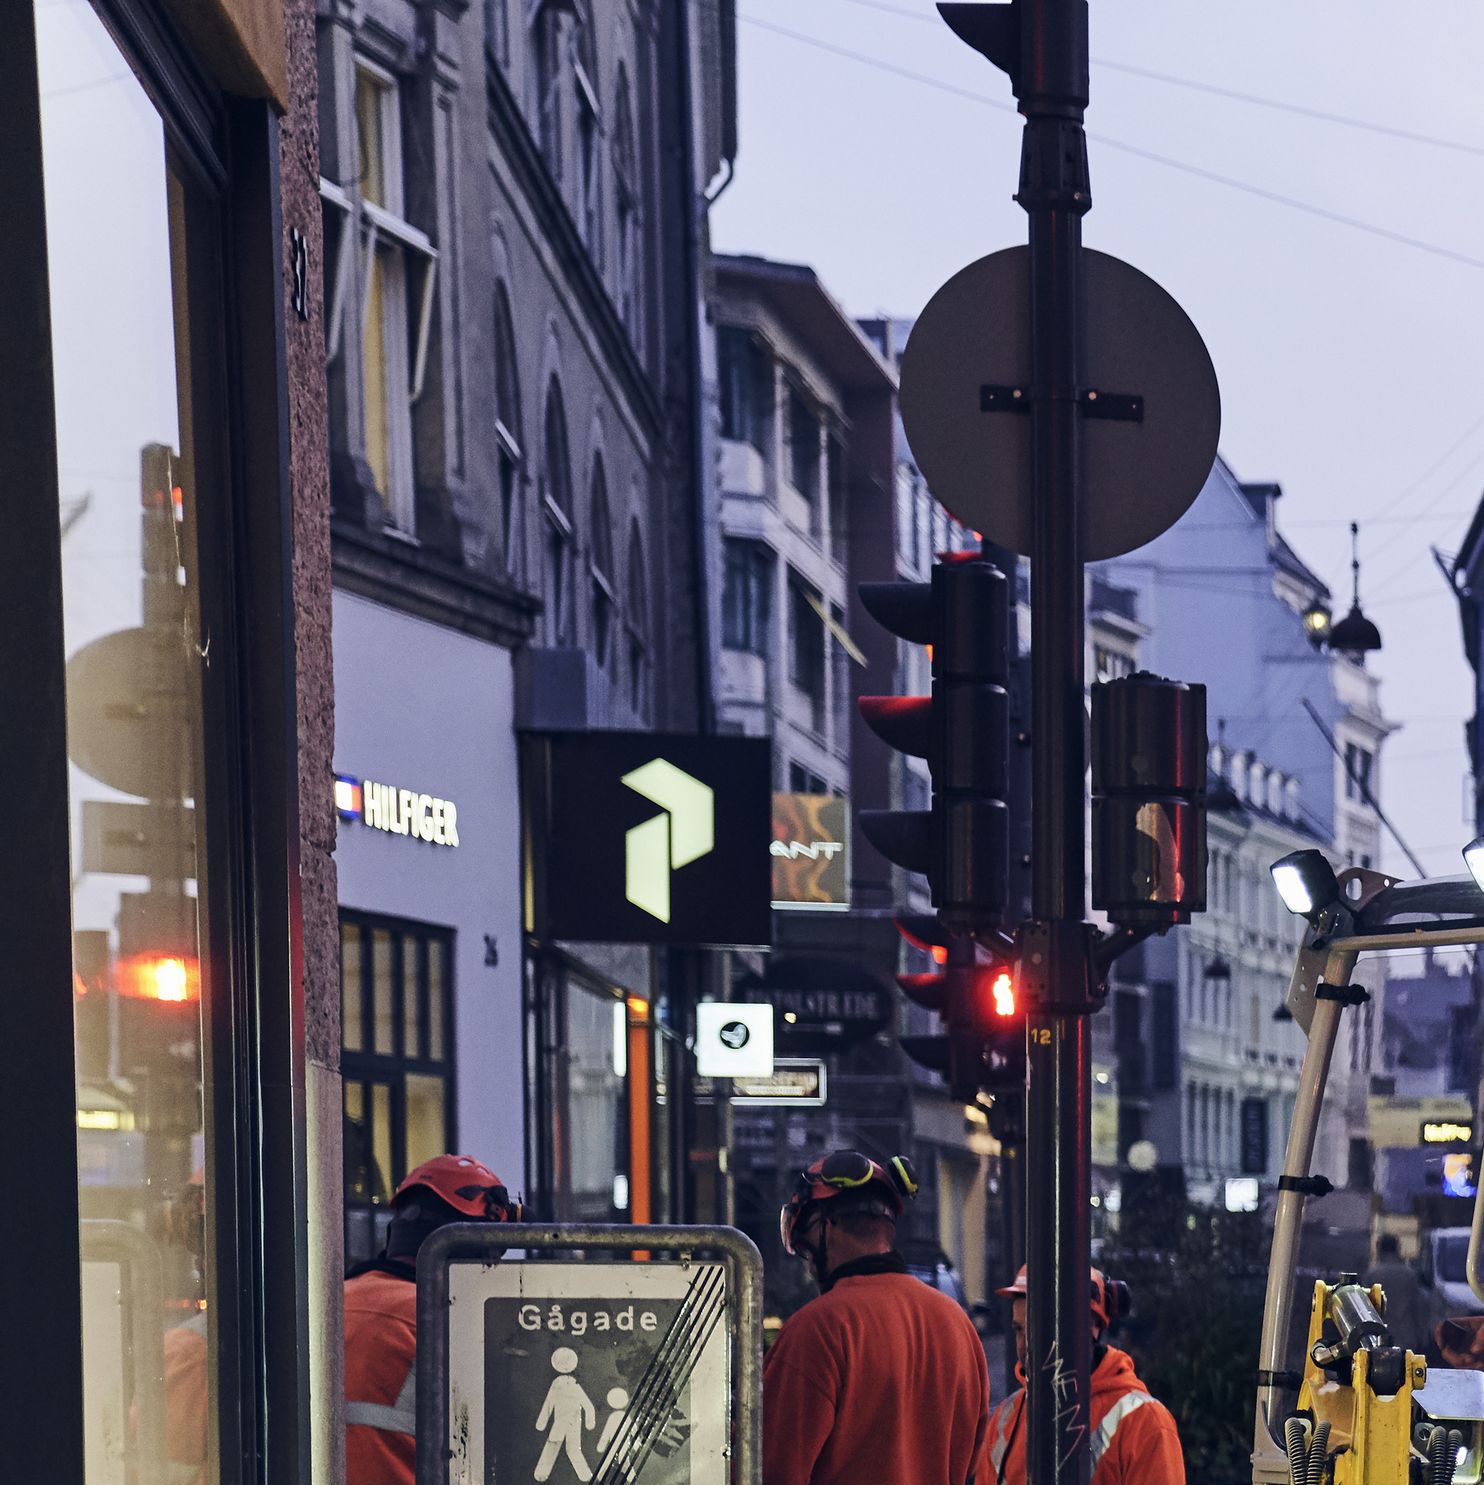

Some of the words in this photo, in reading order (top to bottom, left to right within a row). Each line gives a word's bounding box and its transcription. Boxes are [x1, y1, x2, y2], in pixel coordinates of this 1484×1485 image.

[363, 780, 459, 848] HILFIGER
[1031, 1028, 1051, 1045] 12
[518, 1304, 658, 1336] Gågade
